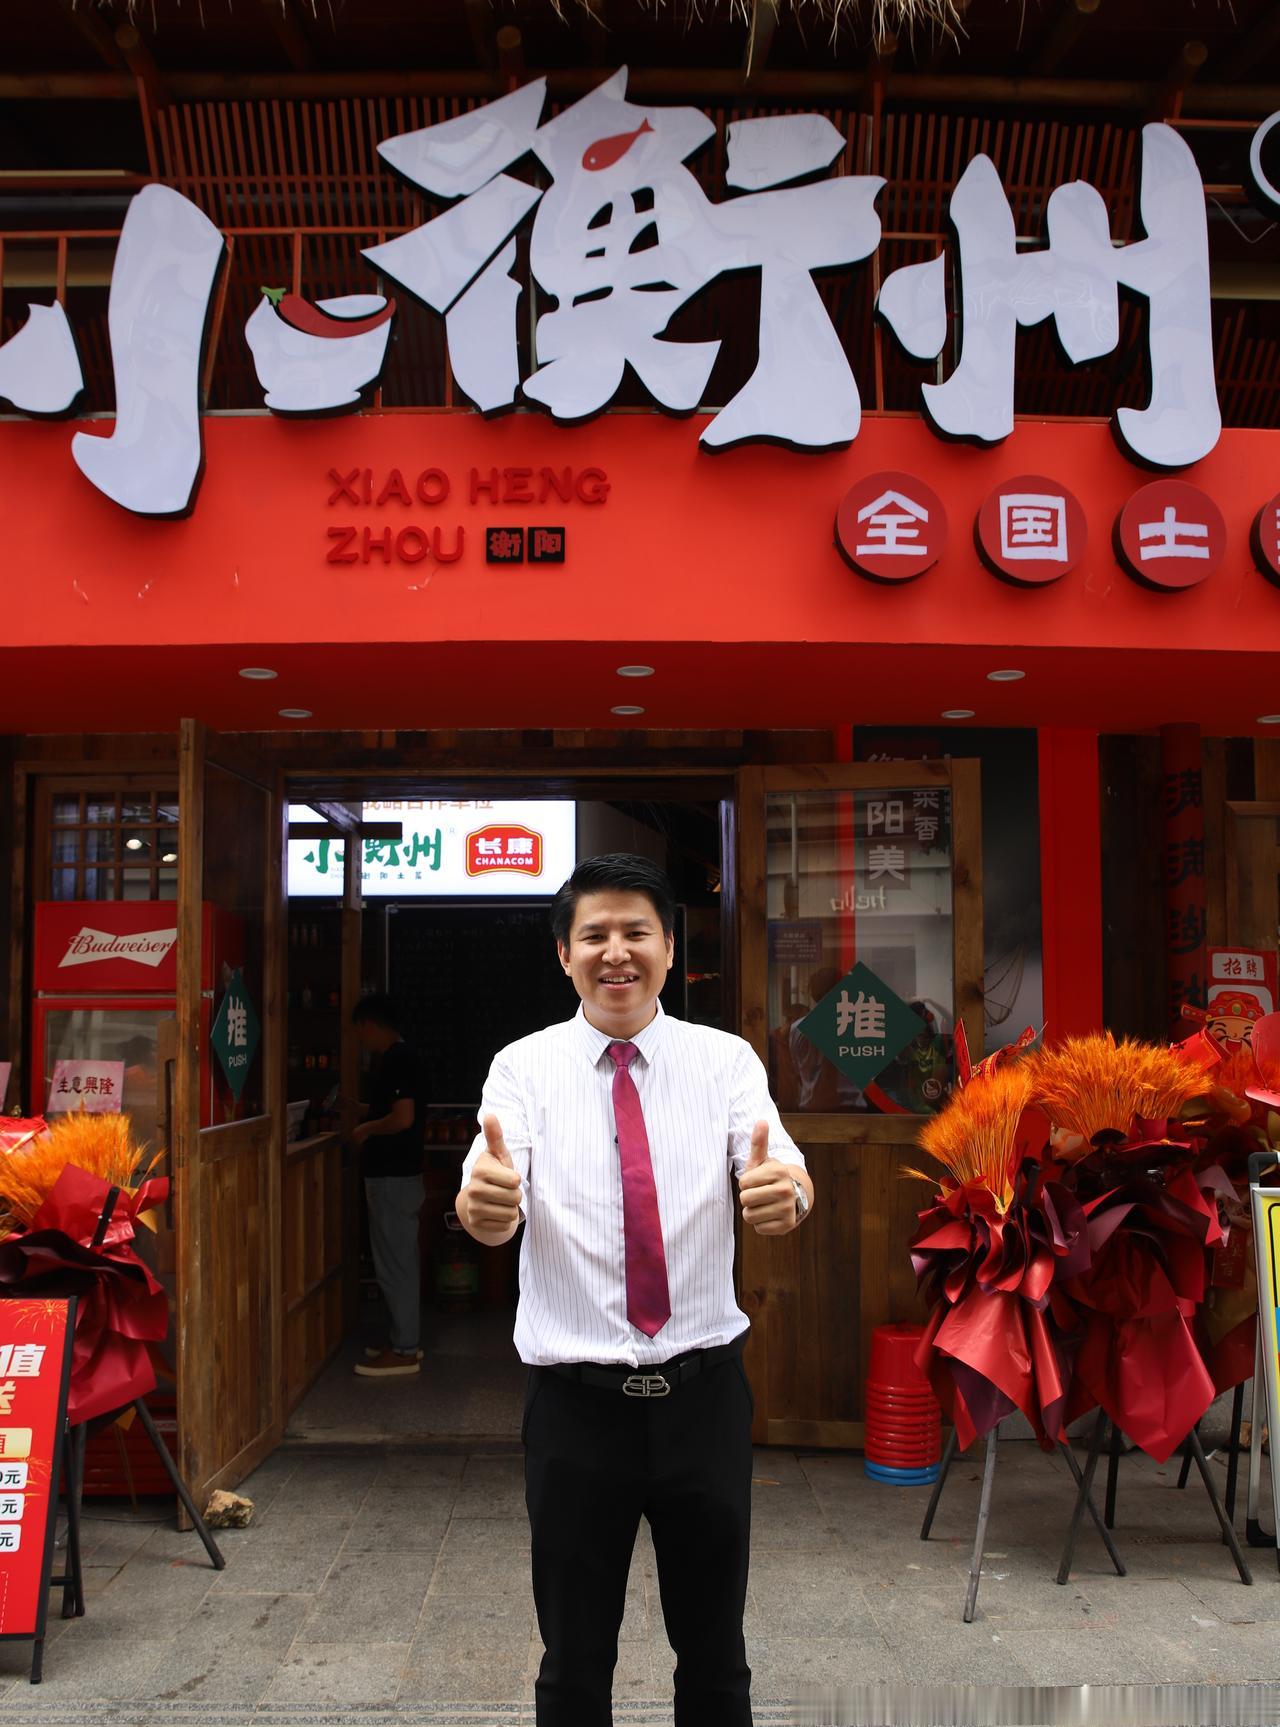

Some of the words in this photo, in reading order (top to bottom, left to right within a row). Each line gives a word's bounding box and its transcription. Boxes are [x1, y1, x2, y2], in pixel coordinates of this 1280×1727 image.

[0, 63, 1222, 516] 小衡州
[328, 467, 451, 506] XIAO
[469, 466, 612, 505] HENG
[856, 489, 1280, 565] 全国土
[327, 525, 465, 564] ZHOU
[475, 837, 534, 855] 长康
[68, 934, 172, 955] Budweiser
[1222, 957, 1258, 978] 招聘
[227, 995, 247, 1047] 推
[836, 990, 886, 1039] 推
[228, 1054, 247, 1068] PUSH
[839, 1044, 886, 1058] PUSH
[56, 1076, 115, 1096] 生意興隆
